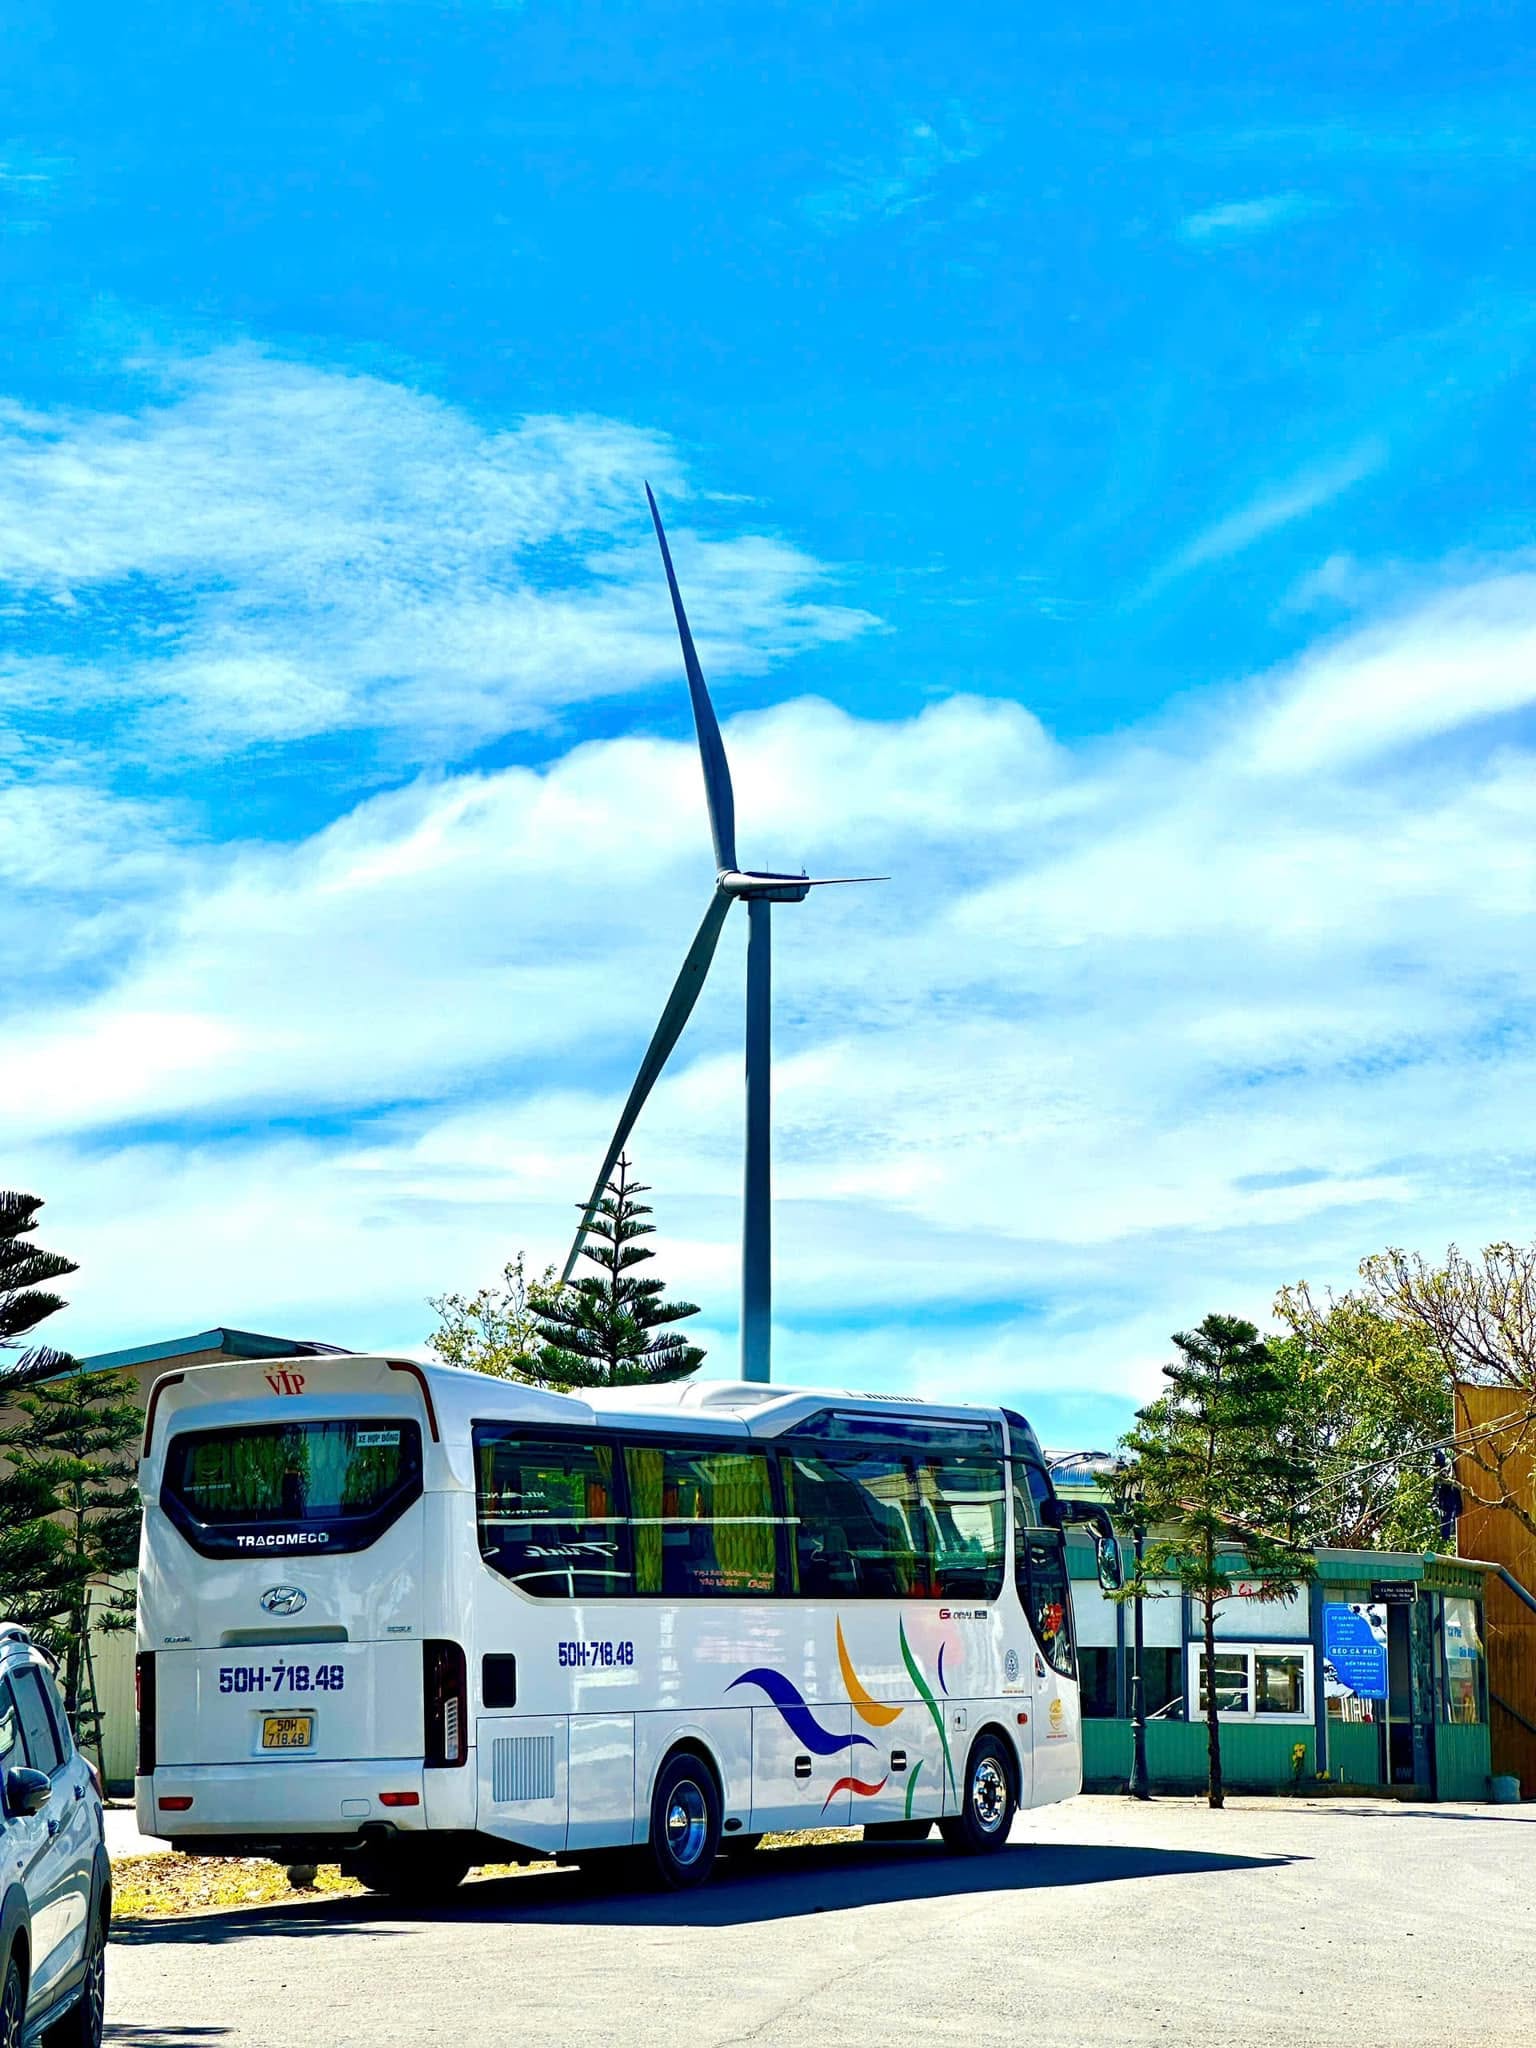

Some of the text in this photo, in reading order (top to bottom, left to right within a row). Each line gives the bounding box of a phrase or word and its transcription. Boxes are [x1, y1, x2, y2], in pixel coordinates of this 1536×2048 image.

[265, 1370, 305, 1396] VIP
[236, 1532, 329, 1547] TRACOMECO
[558, 1641, 634, 1667] 50H-718.48
[219, 1665, 344, 1693] 50H-718.48
[277, 1719, 298, 1732] 50H
[268, 1733, 305, 1745] 718.48
